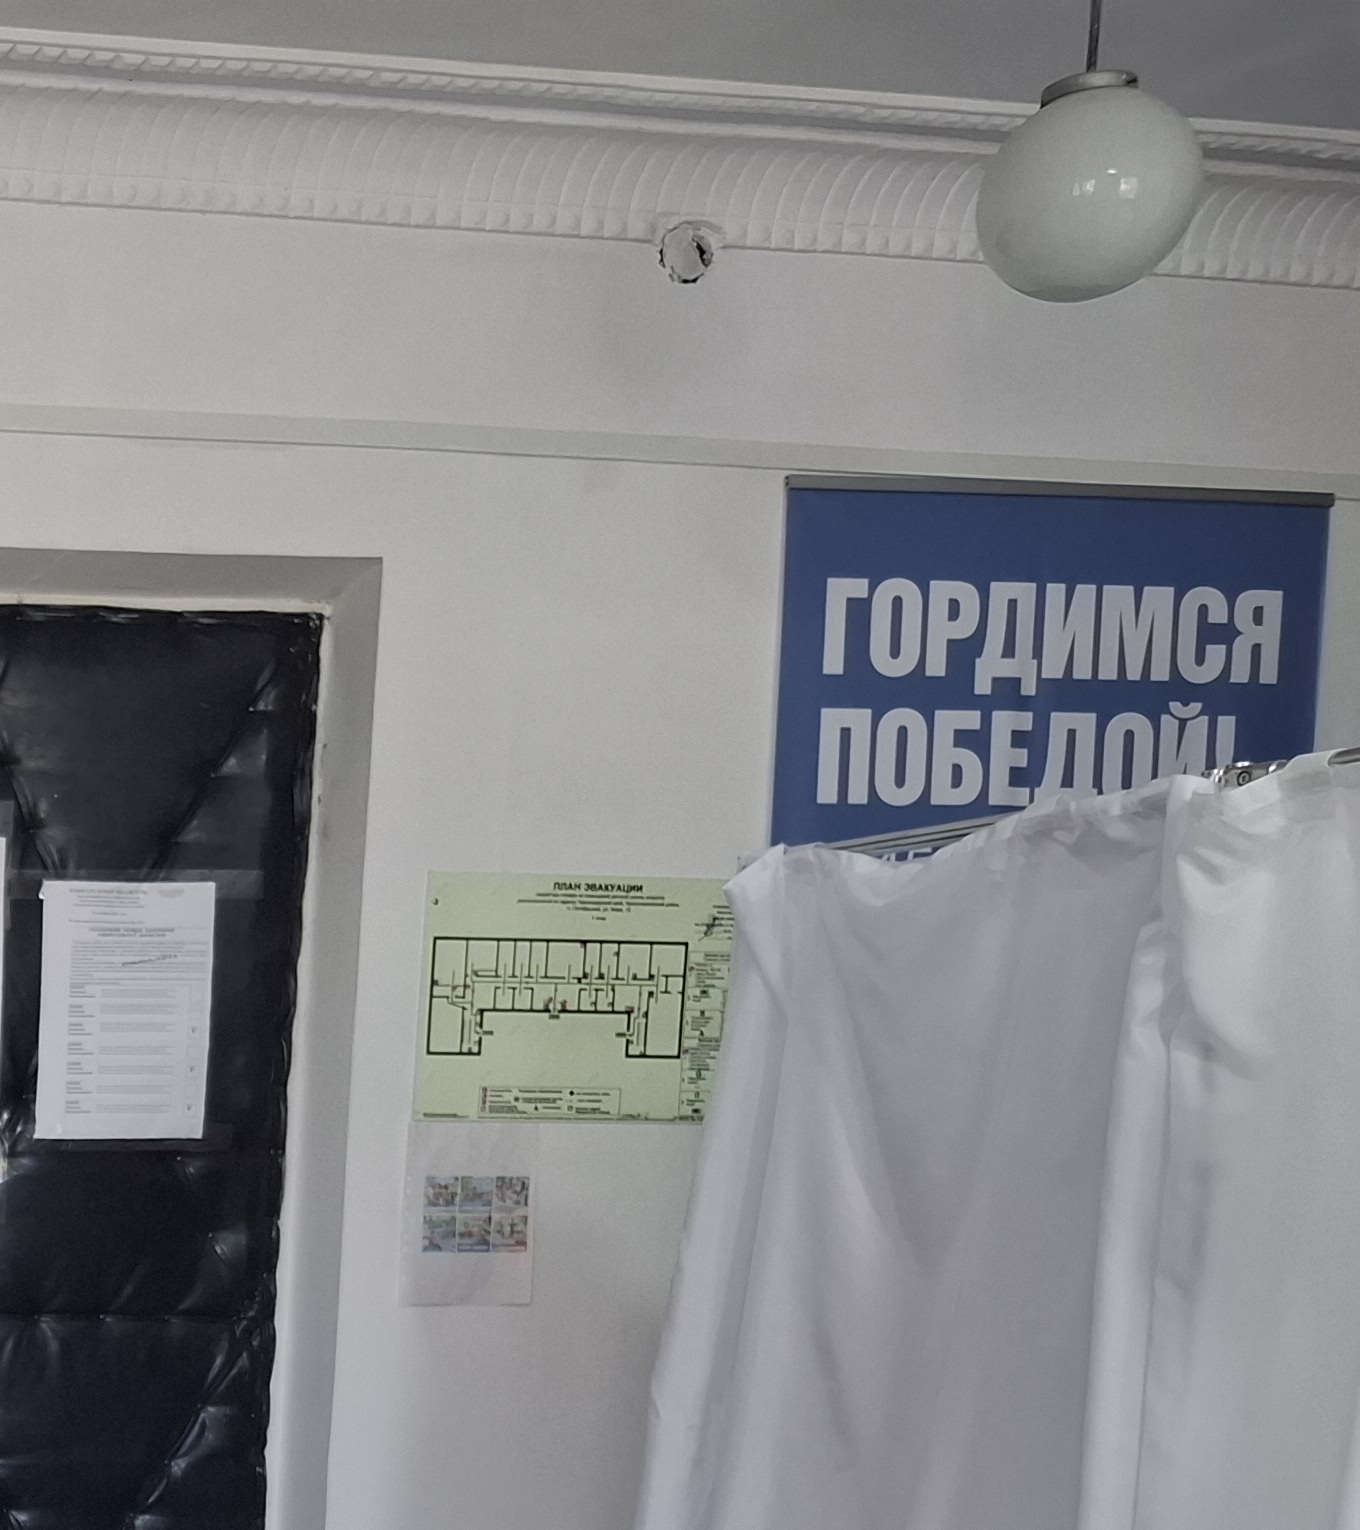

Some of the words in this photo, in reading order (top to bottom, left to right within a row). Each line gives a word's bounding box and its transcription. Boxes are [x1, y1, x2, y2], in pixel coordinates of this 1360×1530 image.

[822, 577, 1284, 696] ГОРДИМСЯ
[553, 882, 581, 891] ПЛАН
[583, 883, 644, 893] ЭВАКУАЦИИ
